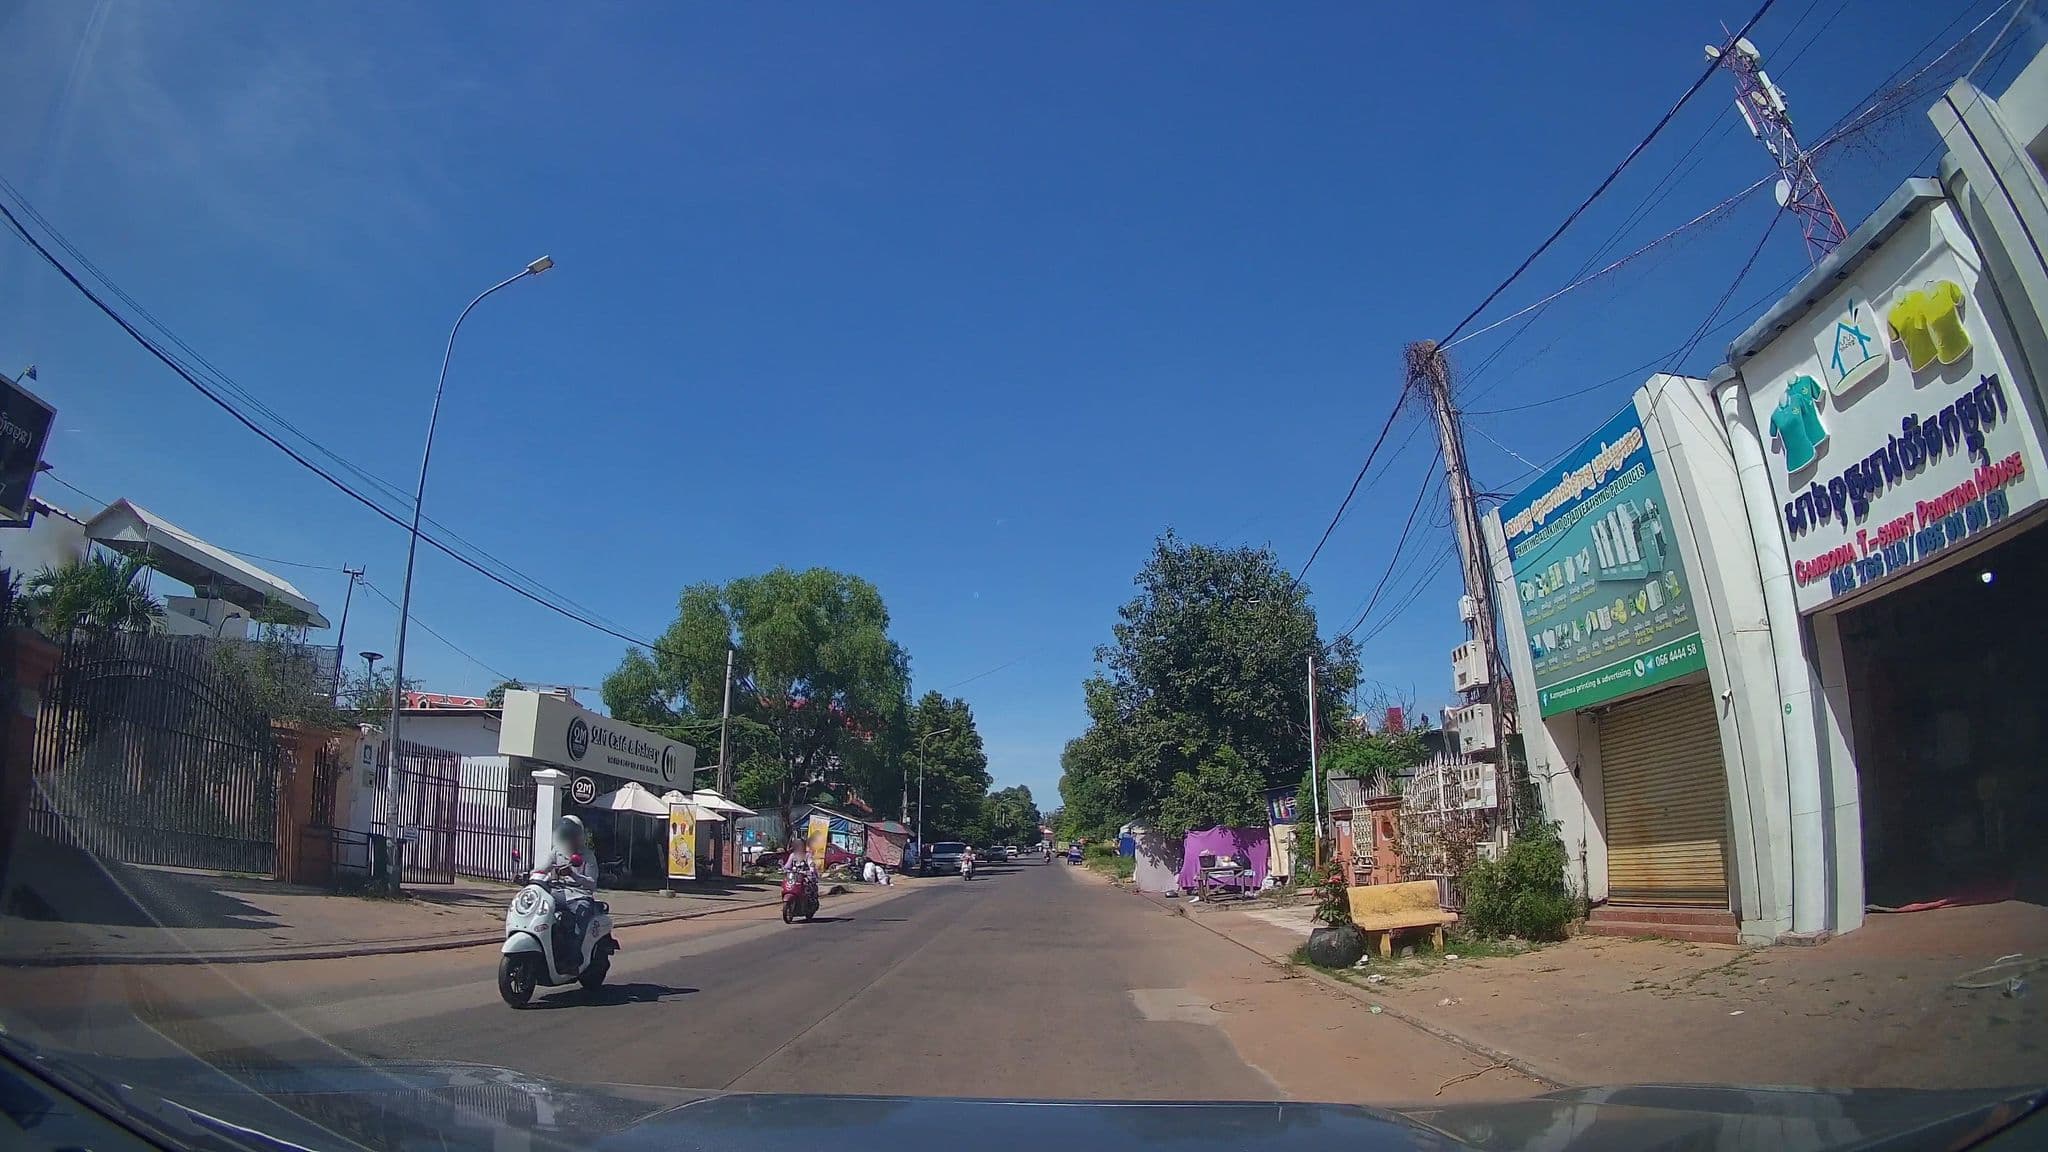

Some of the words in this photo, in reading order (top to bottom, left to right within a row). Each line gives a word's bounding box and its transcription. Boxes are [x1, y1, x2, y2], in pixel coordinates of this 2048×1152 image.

[1609, 462, 1646, 497] PRODUCTS
[1795, 542, 1858, 584] CAMBODIA
[1856, 511, 1915, 554] T-SHIRT
[1915, 479, 1977, 527] PRINTING
[1974, 451, 2025, 495] HOUSE
[1669, 647, 1687, 662] 4444
[1686, 643, 1697, 657] 58
[1576, 679, 1597, 694] printing
[573, 726, 588, 746] 2M
[591, 725, 607, 747] 2M
[576, 781, 592, 794] 2M
